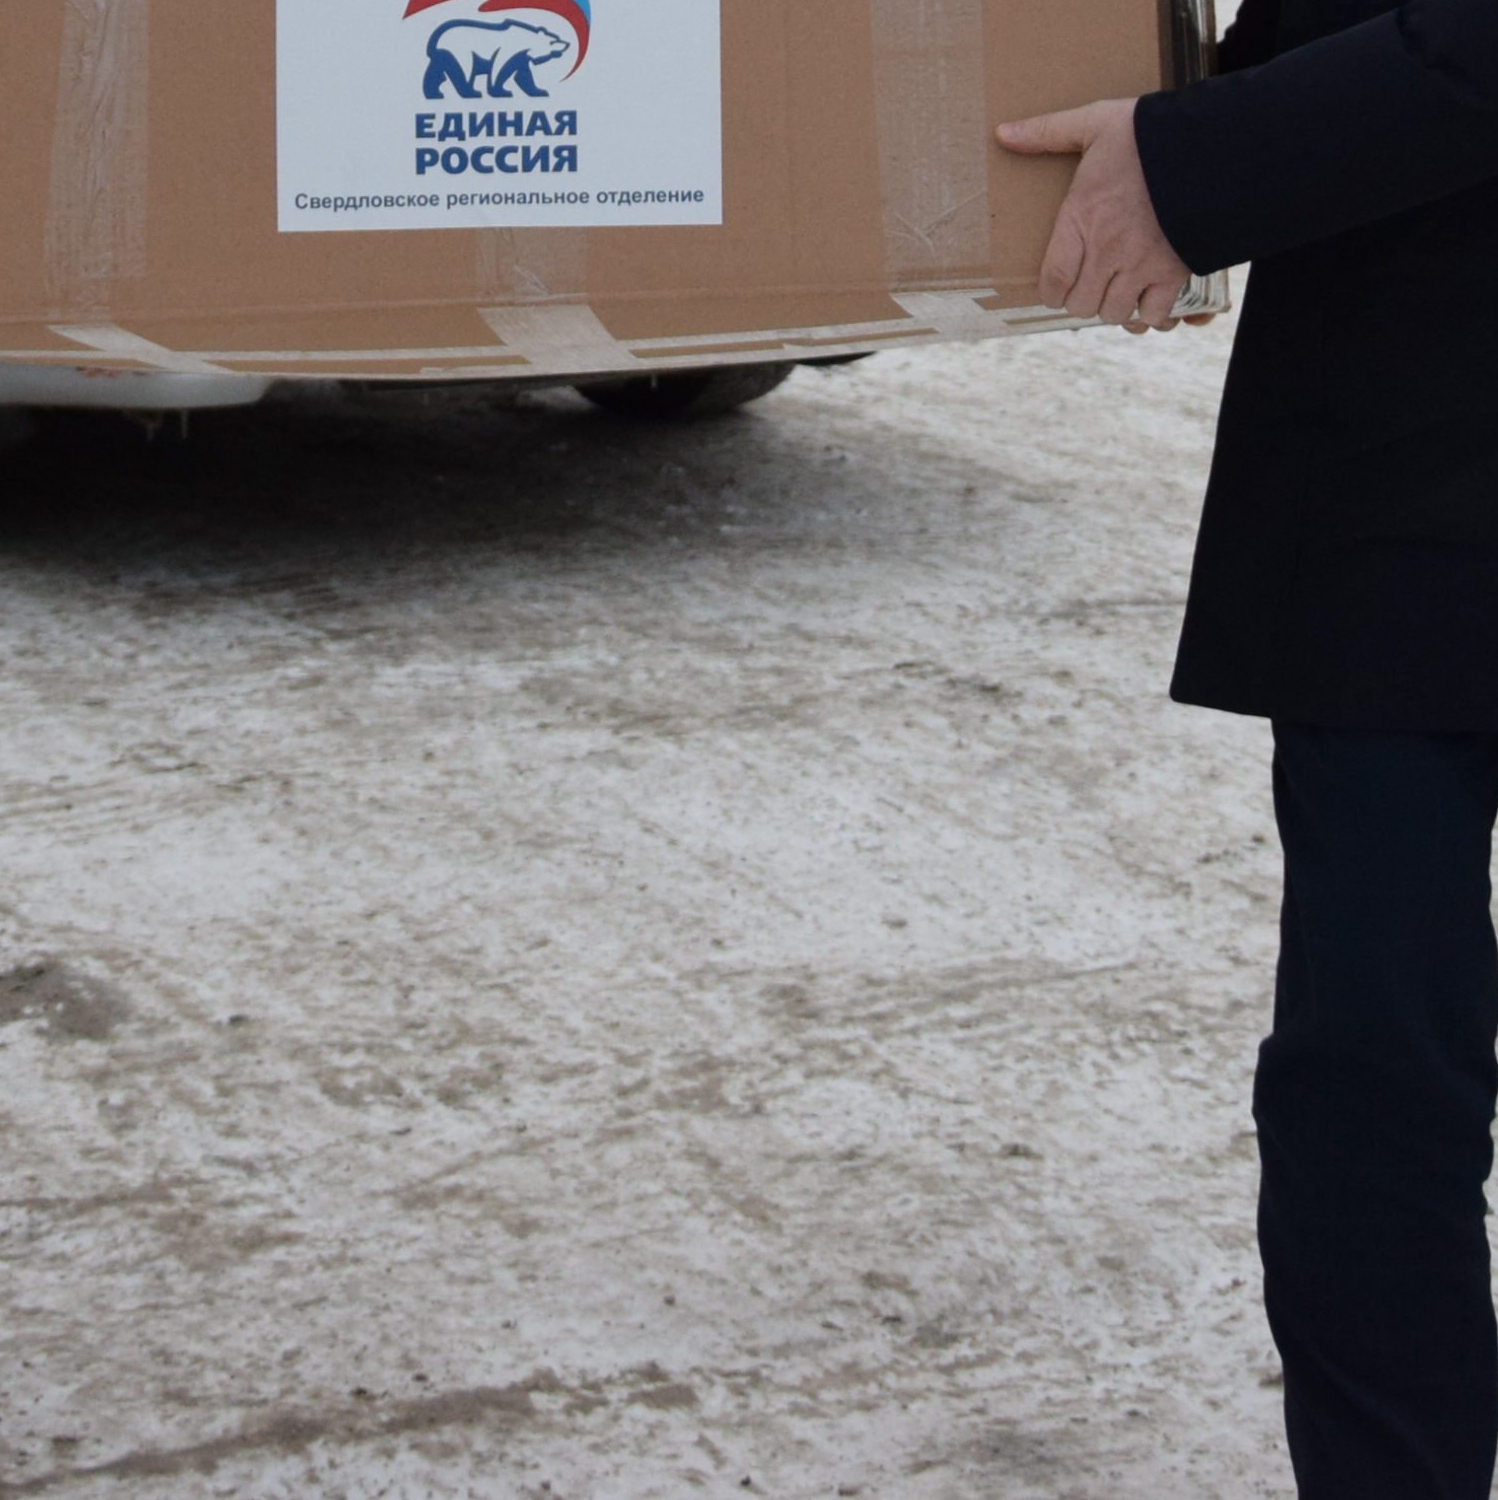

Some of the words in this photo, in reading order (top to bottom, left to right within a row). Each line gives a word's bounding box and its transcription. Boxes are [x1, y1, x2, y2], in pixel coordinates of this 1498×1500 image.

[415, 110, 578, 141] ЕДИНАЯ
[415, 145, 578, 175] РОССИЯ
[294, 192, 440, 212] Свердловское
[446, 191, 590, 210] региональное
[596, 189, 705, 206] отделение
